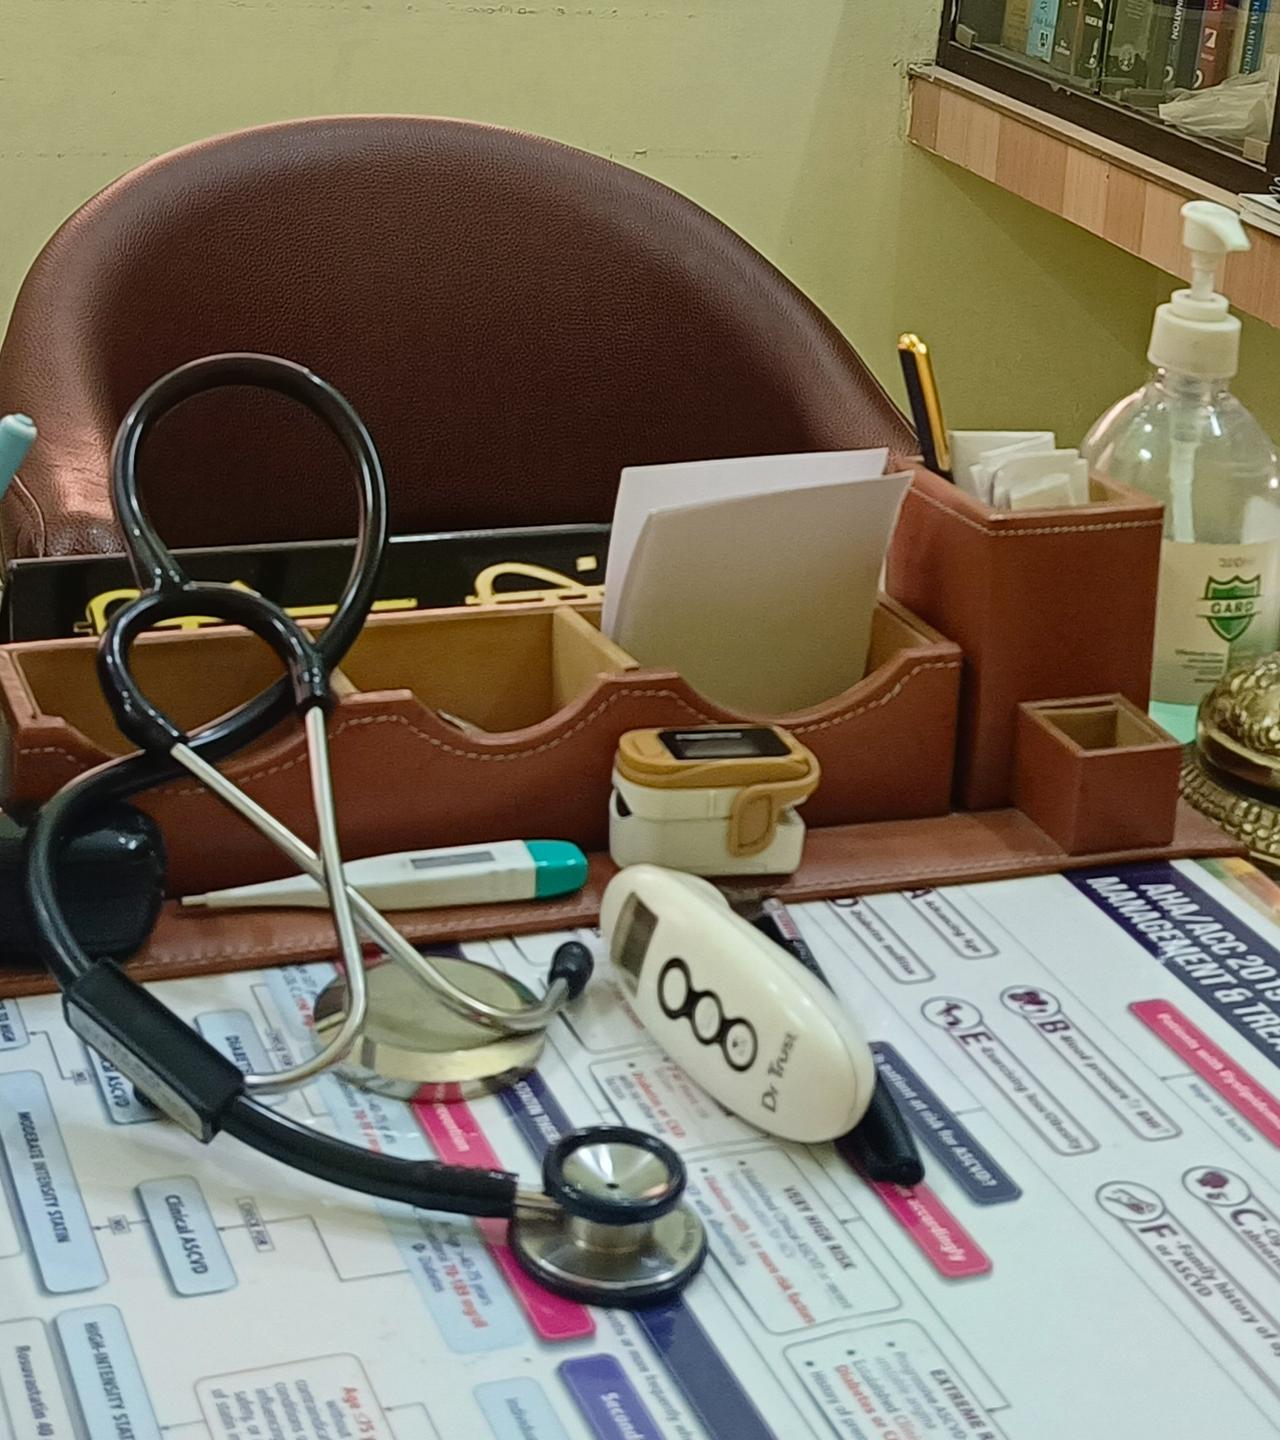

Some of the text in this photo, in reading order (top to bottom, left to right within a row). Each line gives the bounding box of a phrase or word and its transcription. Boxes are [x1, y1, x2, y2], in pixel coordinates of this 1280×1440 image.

[1086, 876, 1238, 986] MANAGEMENT
[1214, 987, 1254, 1003] &
[1139, 883, 1248, 955] AHA/ACC
[958, 1031, 994, 1047] E
[1037, 1019, 1070, 1034] B
[1157, 1013, 1200, 1050] Patients
[108, 1076, 131, 1107] ASCVD
[761, 1032, 798, 1113] Dr Trust
[18, 1112, 71, 1243] MODERATE INTENSITY STATIN
[953, 1146, 998, 1187] ASCVD?
[165, 1194, 209, 1275] Clinical ASCVD
[783, 1184, 858, 1271] VERY HIGH RISK
[1230, 1208, 1268, 1227] C
[1139, 1223, 1179, 1239] F
[1214, 1281, 1260, 1324] history
[1255, 1323, 1278, 1340] of
[1155, 1242, 1214, 1298] or ASCVD
[15, 1345, 54, 1437] Rosuvastatin 40
[84, 1322, 122, 1412] HIGH-INTENSITY
[929, 1368, 987, 1429] EXTREME
[342, 1387, 362, 1414] Age
